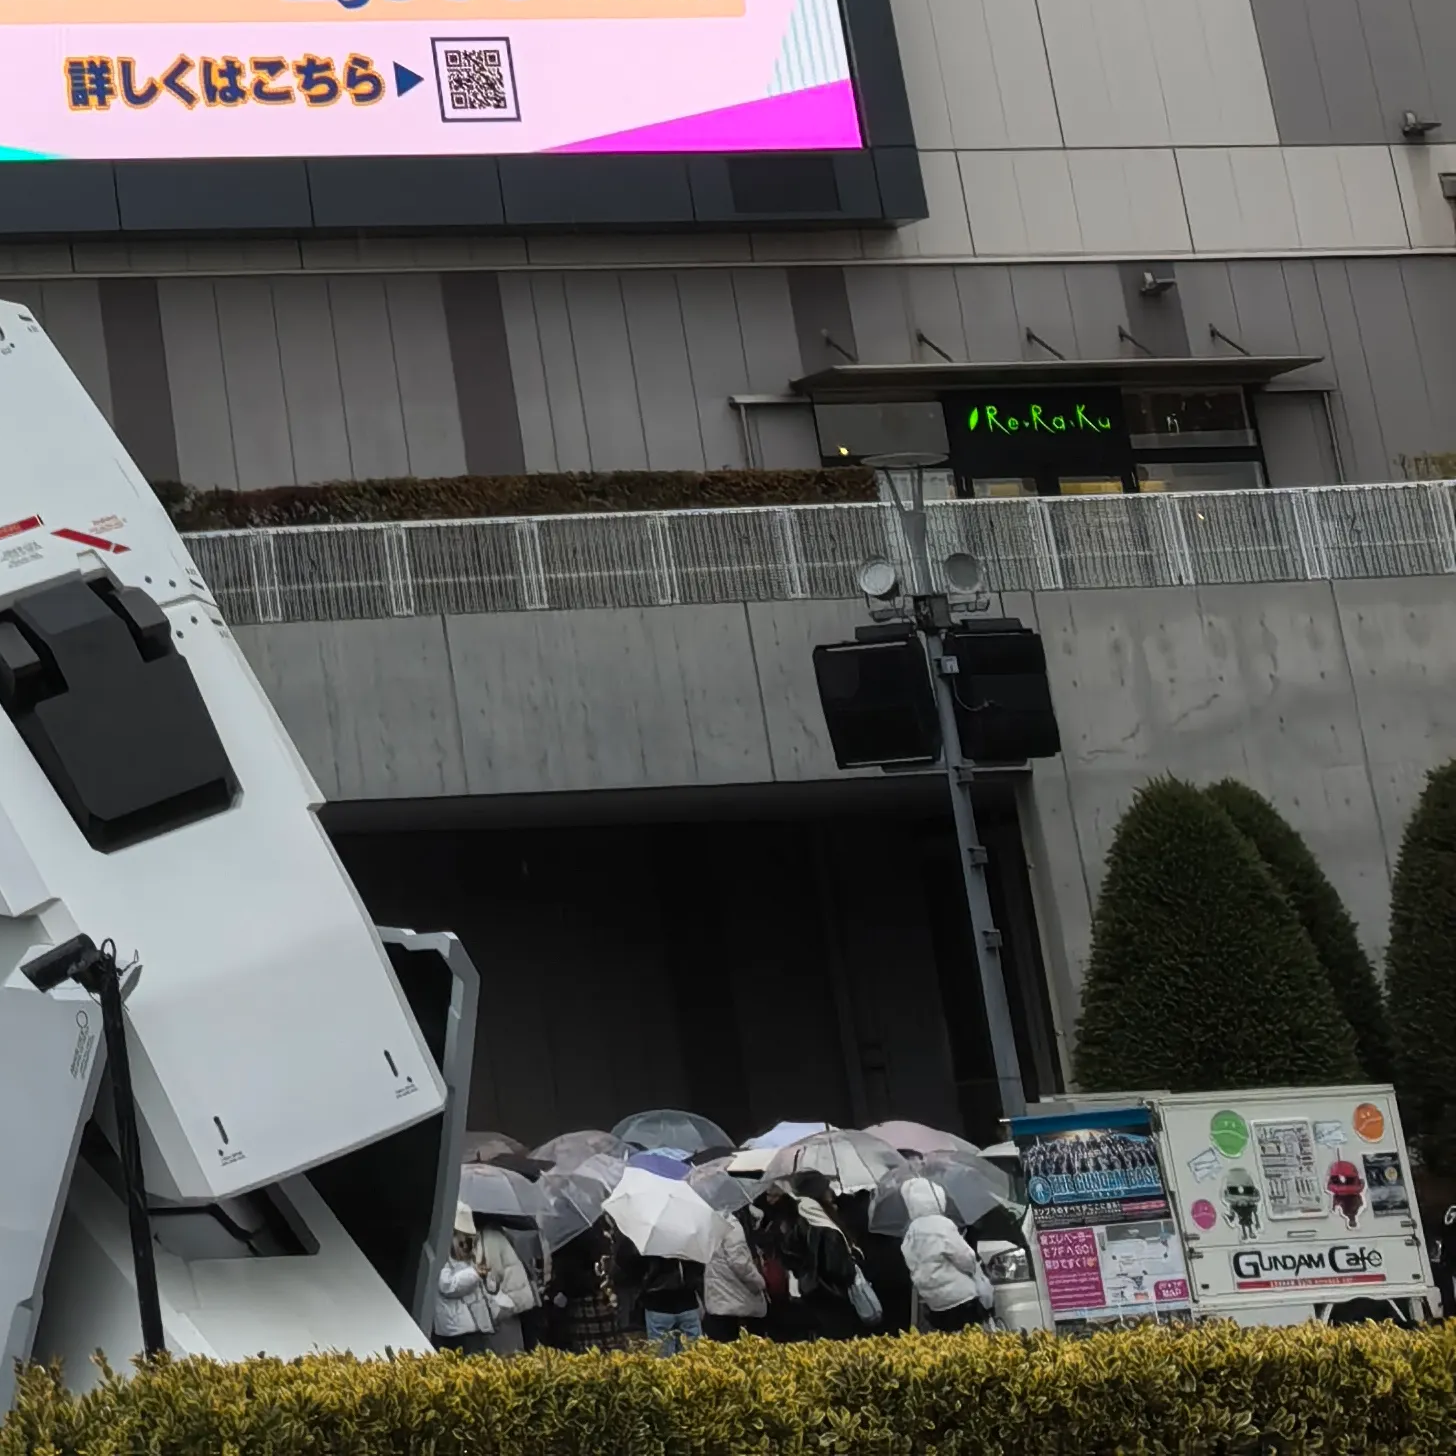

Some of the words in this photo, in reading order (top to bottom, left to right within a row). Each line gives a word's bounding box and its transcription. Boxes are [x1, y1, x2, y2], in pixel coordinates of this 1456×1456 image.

[65, 53, 387, 111] 詳しくはこちら
[1074, 1168, 1128, 1192] GUNDAM
[1233, 1250, 1326, 1278] GUNDAM
